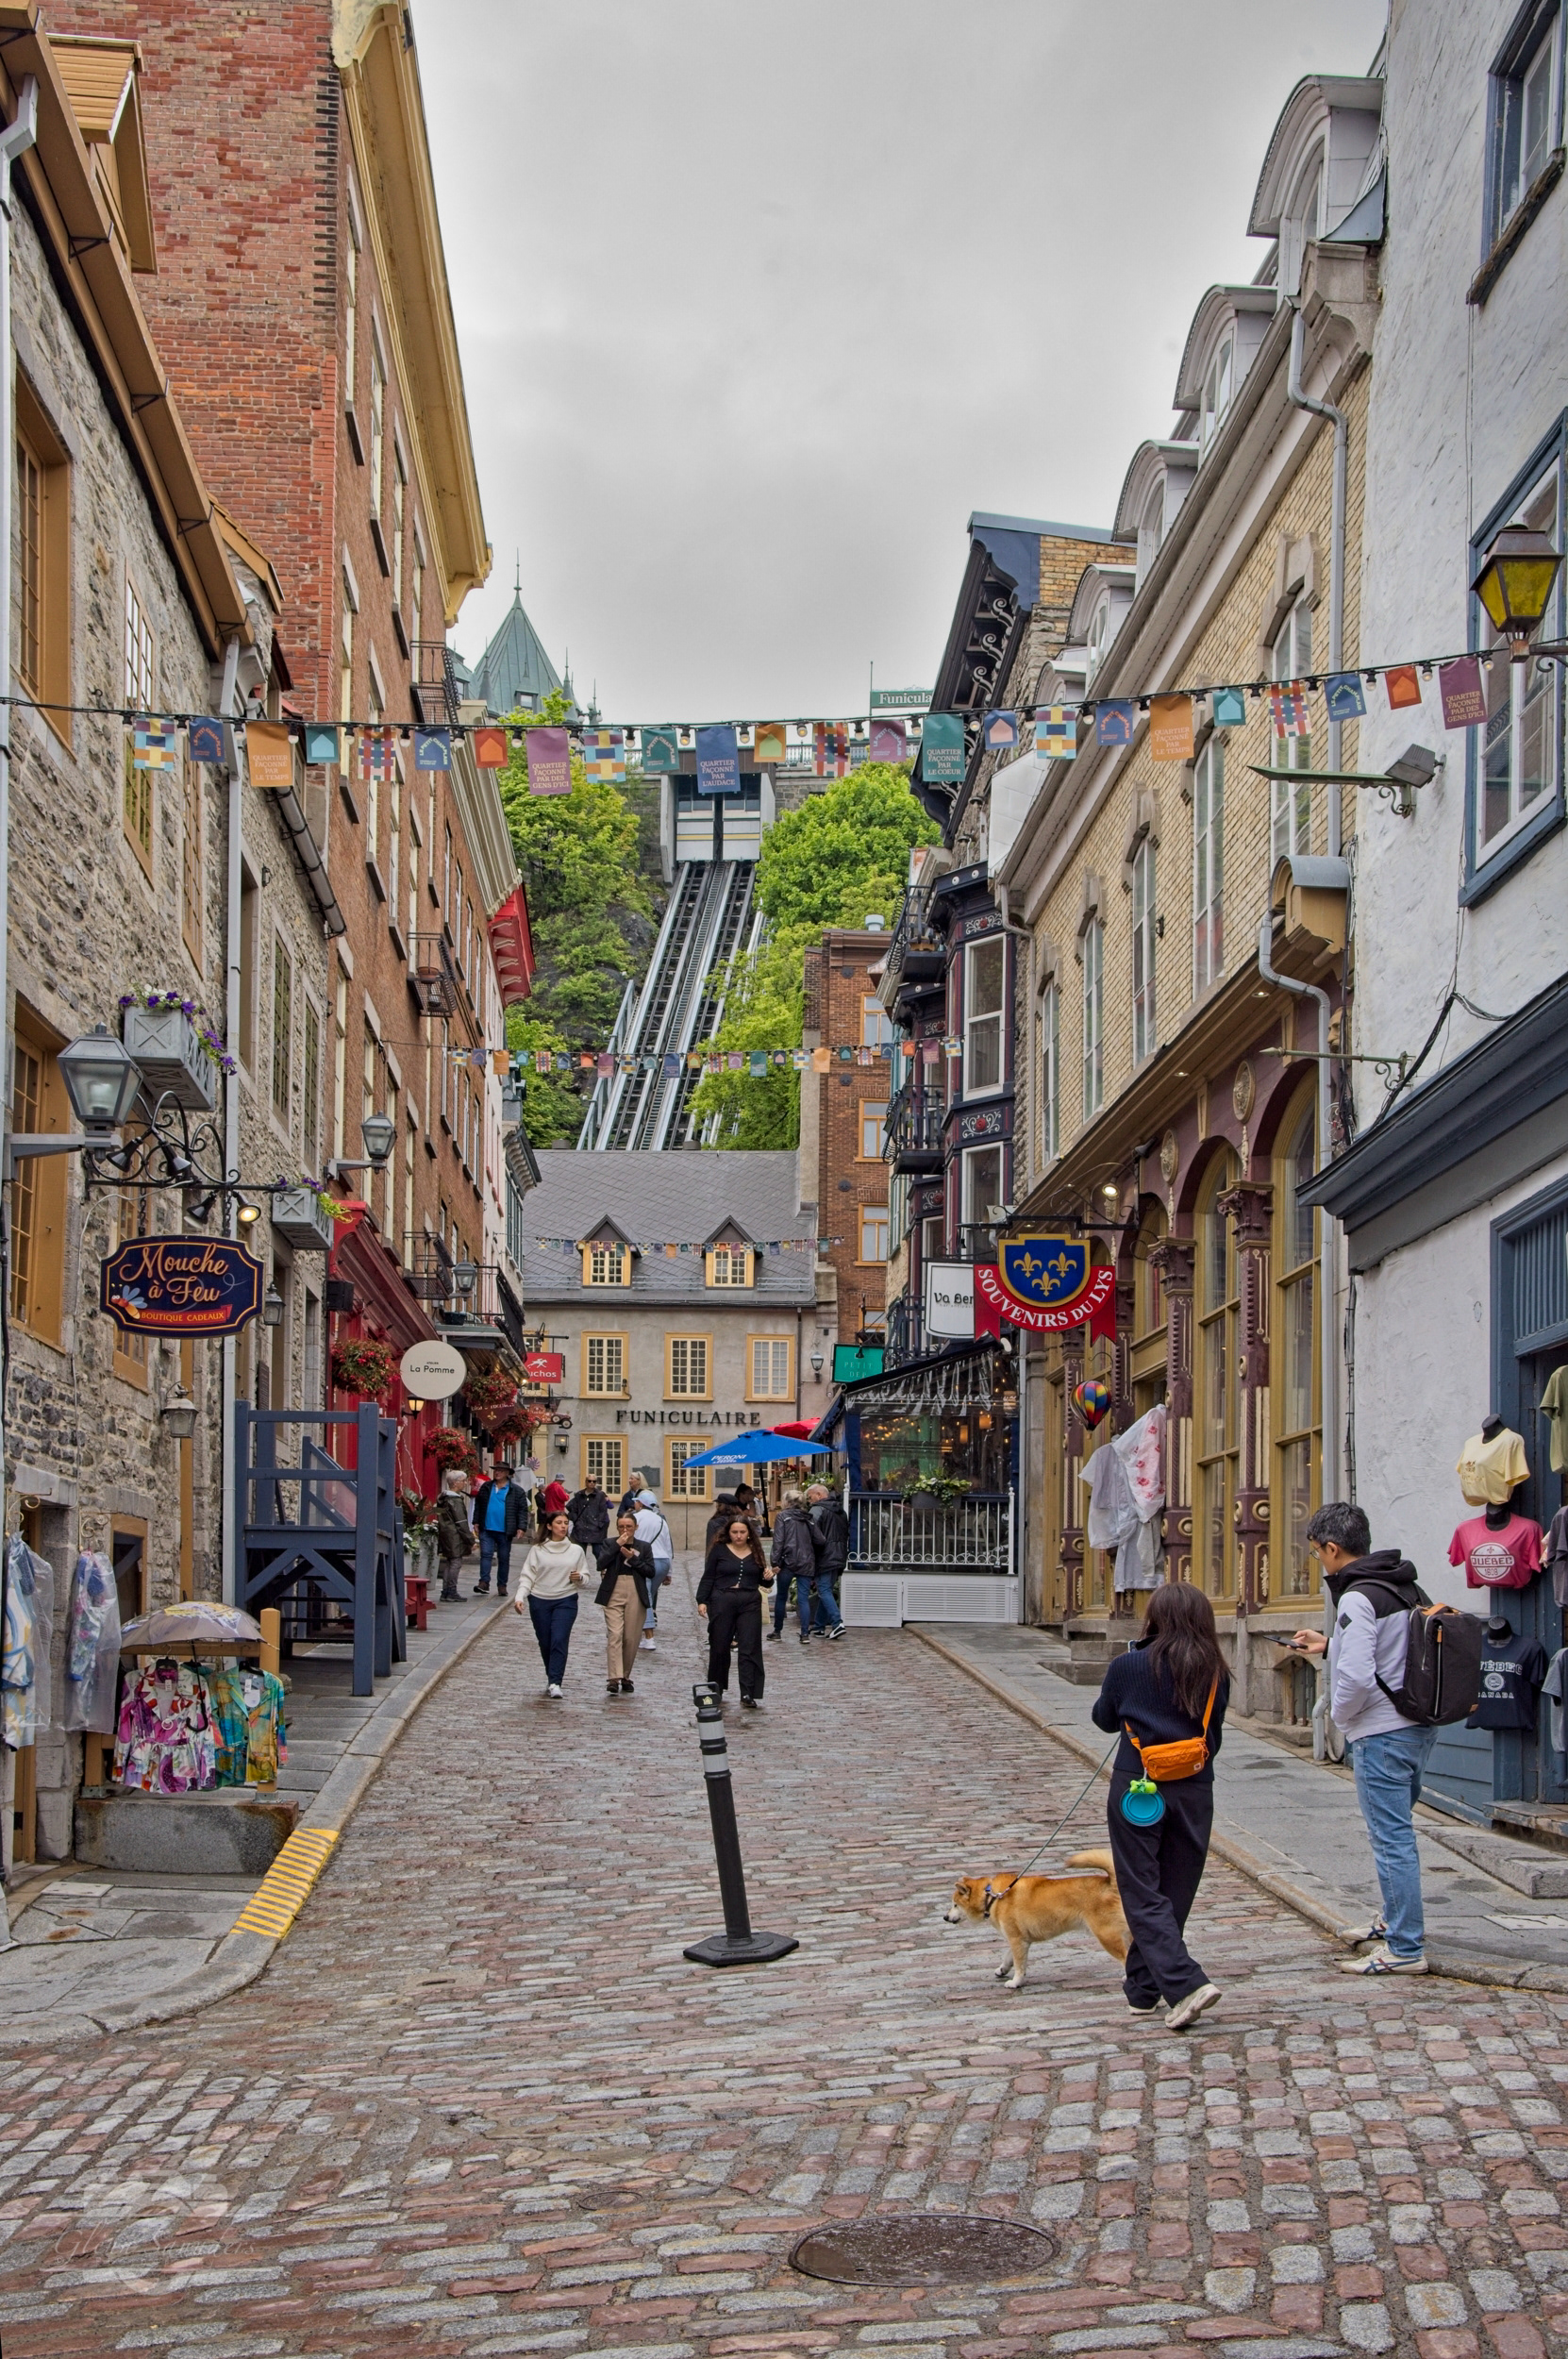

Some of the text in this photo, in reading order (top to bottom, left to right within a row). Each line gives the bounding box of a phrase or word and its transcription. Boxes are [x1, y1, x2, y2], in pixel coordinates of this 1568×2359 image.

[1446, 691, 1480, 703] QUARTIER
[1448, 698, 1480, 710] FAÇONNÉ
[1451, 704, 1479, 715] PAR DES
[1447, 714, 1467, 723] GENS
[1155, 727, 1190, 735] QUARTIER
[532, 761, 567, 770] QUARTIER
[702, 765, 734, 774] FAÇONNÉ
[534, 768, 566, 777] FAÇONNÉ
[119, 1242, 229, 1281] Mouche
[148, 1276, 221, 1305] à Feu
[934, 1292, 951, 1304] Va
[977, 1268, 1113, 1328] SOUVENIRS DU LYS
[142, 1312, 225, 1322] BOUTIQUE CADEAUX
[409, 1364, 455, 1374] La Pomme
[616, 1410, 760, 1425] FUNICULAIRE
[1471, 1556, 1513, 1565] QUÉBEC
